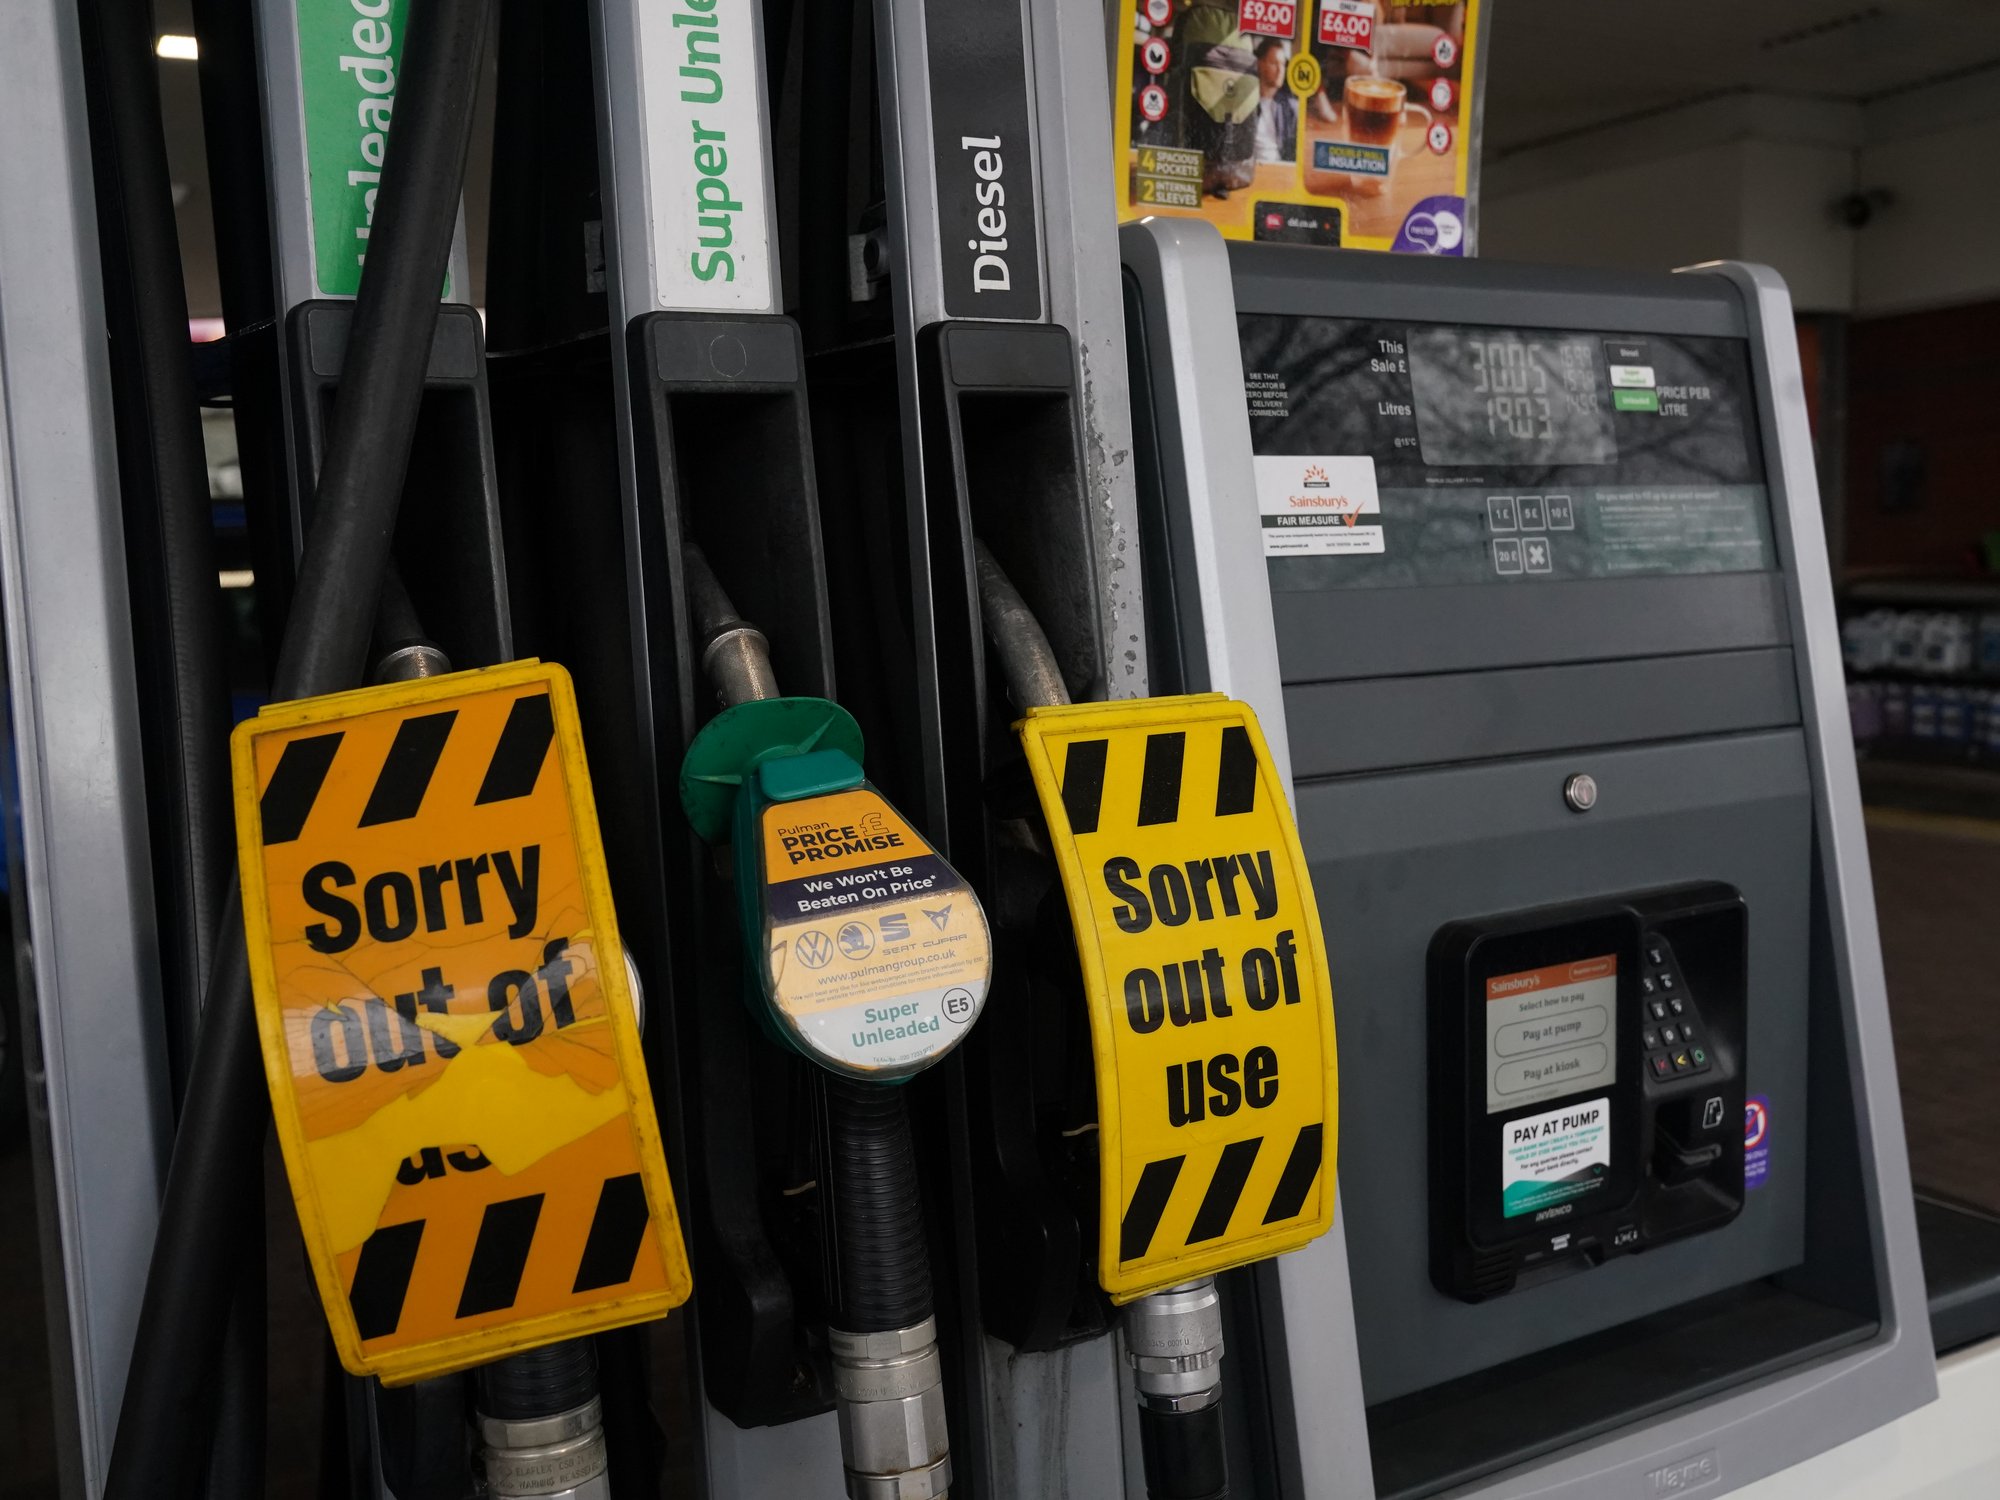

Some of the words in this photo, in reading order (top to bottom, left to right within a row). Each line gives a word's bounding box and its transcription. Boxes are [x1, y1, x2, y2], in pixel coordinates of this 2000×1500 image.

[1243, 0, 1292, 25] £9.00
[1323, 12, 1370, 36] £6.00
[339, 0, 396, 266] leade
[1142, 150, 1155, 172] 4
[1156, 163, 1199, 176] POCKETS
[1329, 156, 1386, 172] INSULATION
[691, 120, 743, 282] Super
[1143, 180, 1155, 201] 2
[1156, 191, 1197, 206] SLEEVES
[961, 135, 1011, 293] Diesel
[1378, 339, 1404, 354] This
[1371, 359, 1396, 373] Sale
[1398, 360, 1406, 373] £
[1656, 386, 1688, 400] PRICE
[1688, 386, 1711, 400] PER
[1378, 402, 1412, 416] Litres
[1658, 403, 1688, 417] LITRE
[1289, 495, 1348, 510] Sainsbury's
[1277, 516, 1298, 526] FAIR
[1298, 515, 1340, 526] MEASURE
[777, 821, 830, 837] Pulman
[781, 825, 859, 851] PRICE
[788, 833, 905, 865] PROMISE
[803, 879, 834, 894] We
[835, 869, 887, 888] Won't
[889, 864, 914, 878] Be
[302, 844, 542, 955] Sorry
[797, 890, 860, 913] Beaten
[861, 886, 888, 900] On
[1102, 849, 1278, 935] Sorry
[882, 943, 916, 956] SEAT
[817, 948, 957, 986] www.pulmangroup.co.uk
[1123, 947, 1233, 1036] out
[1241, 929, 1301, 1013] of
[1491, 975, 1541, 994] Sainsbury's
[309, 965, 461, 1084] out
[486, 935, 580, 1046] of
[864, 1001, 920, 1024] Super
[946, 997, 970, 1015] E5
[1519, 1000, 1543, 1012] Select
[1544, 996, 1560, 1007] how
[1560, 995, 1569, 1003] to
[1570, 993, 1585, 1004] pay
[851, 1016, 941, 1049] Unleaded
[1523, 1029, 1541, 1041] Pay
[1542, 1026, 1552, 1037] at
[1554, 1021, 1582, 1036] pump
[1523, 1068, 1542, 1081] Pay
[1543, 1065, 1553, 1075] at
[1555, 1058, 1581, 1073] kiosk
[1166, 1045, 1279, 1128] use
[1513, 1124, 1539, 1144] PAY
[1542, 1119, 1558, 1136] AT
[1562, 1109, 1600, 1131] PUMP
